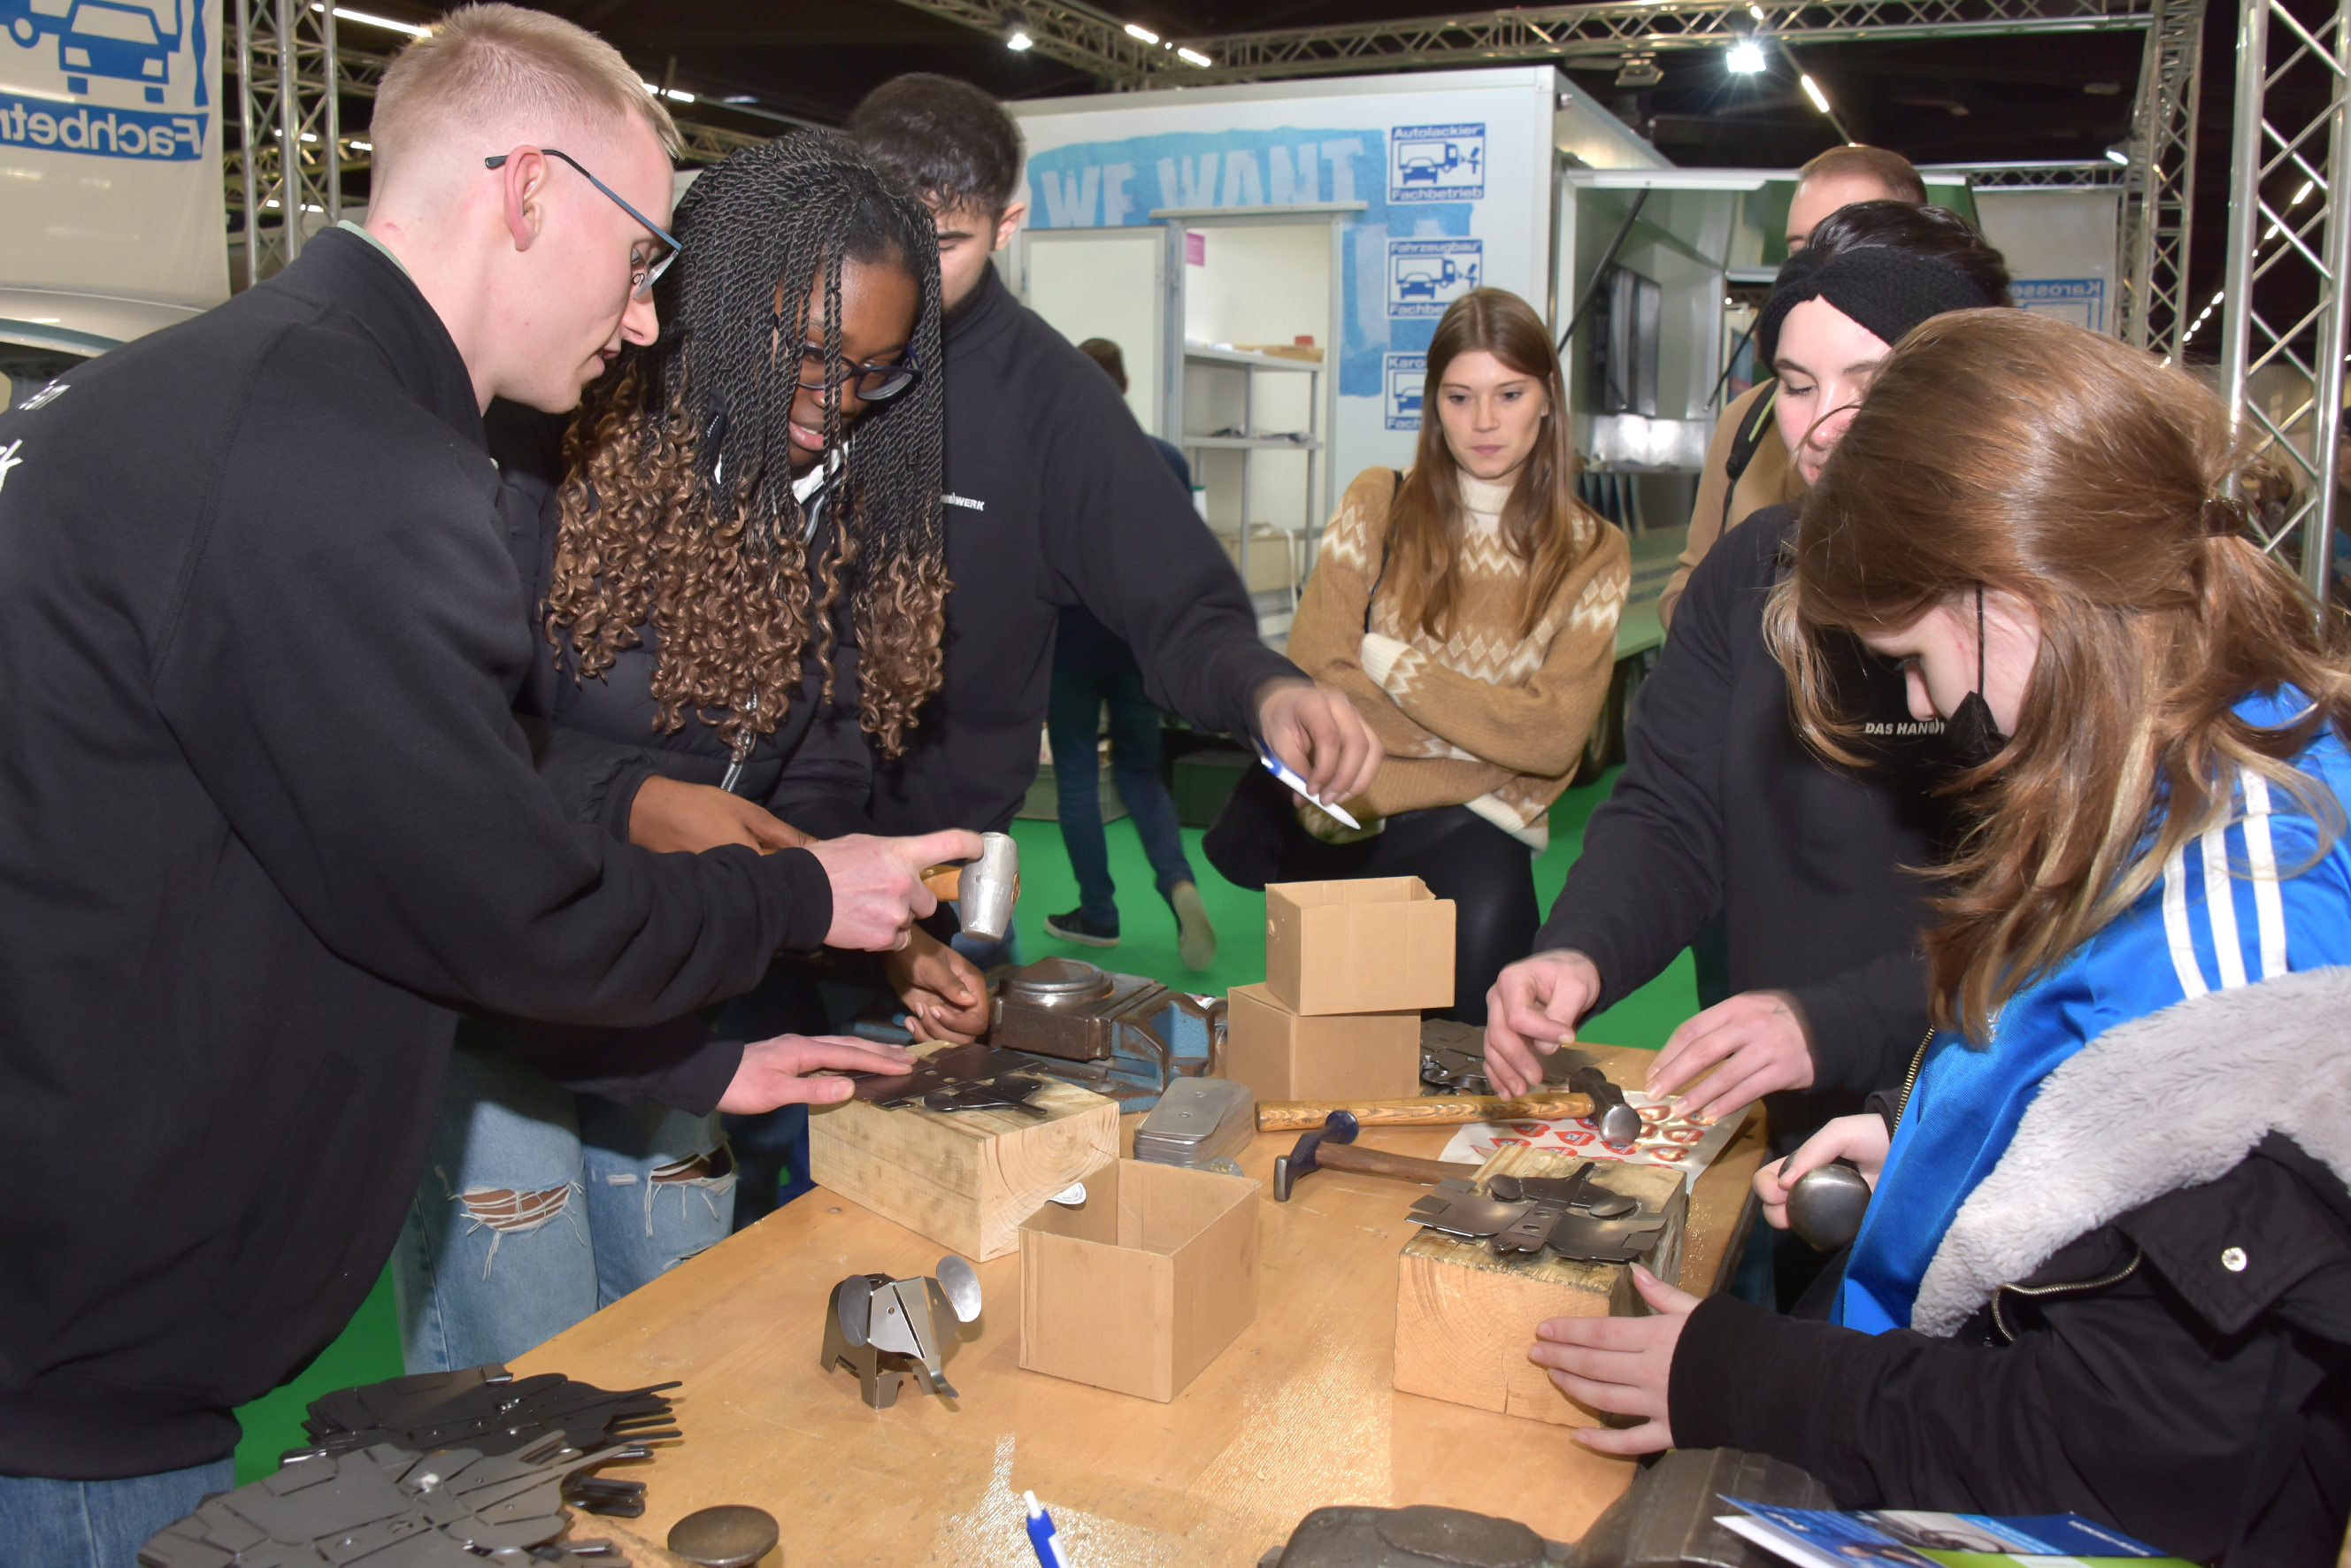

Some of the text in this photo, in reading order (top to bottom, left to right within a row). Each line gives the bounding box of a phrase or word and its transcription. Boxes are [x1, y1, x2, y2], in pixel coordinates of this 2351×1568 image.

[1156, 138, 1364, 209] WANT
[1392, 187, 1483, 200] Fachbetrieb
[1388, 357, 1427, 369] Karo
[1864, 721, 1894, 735] DAS
